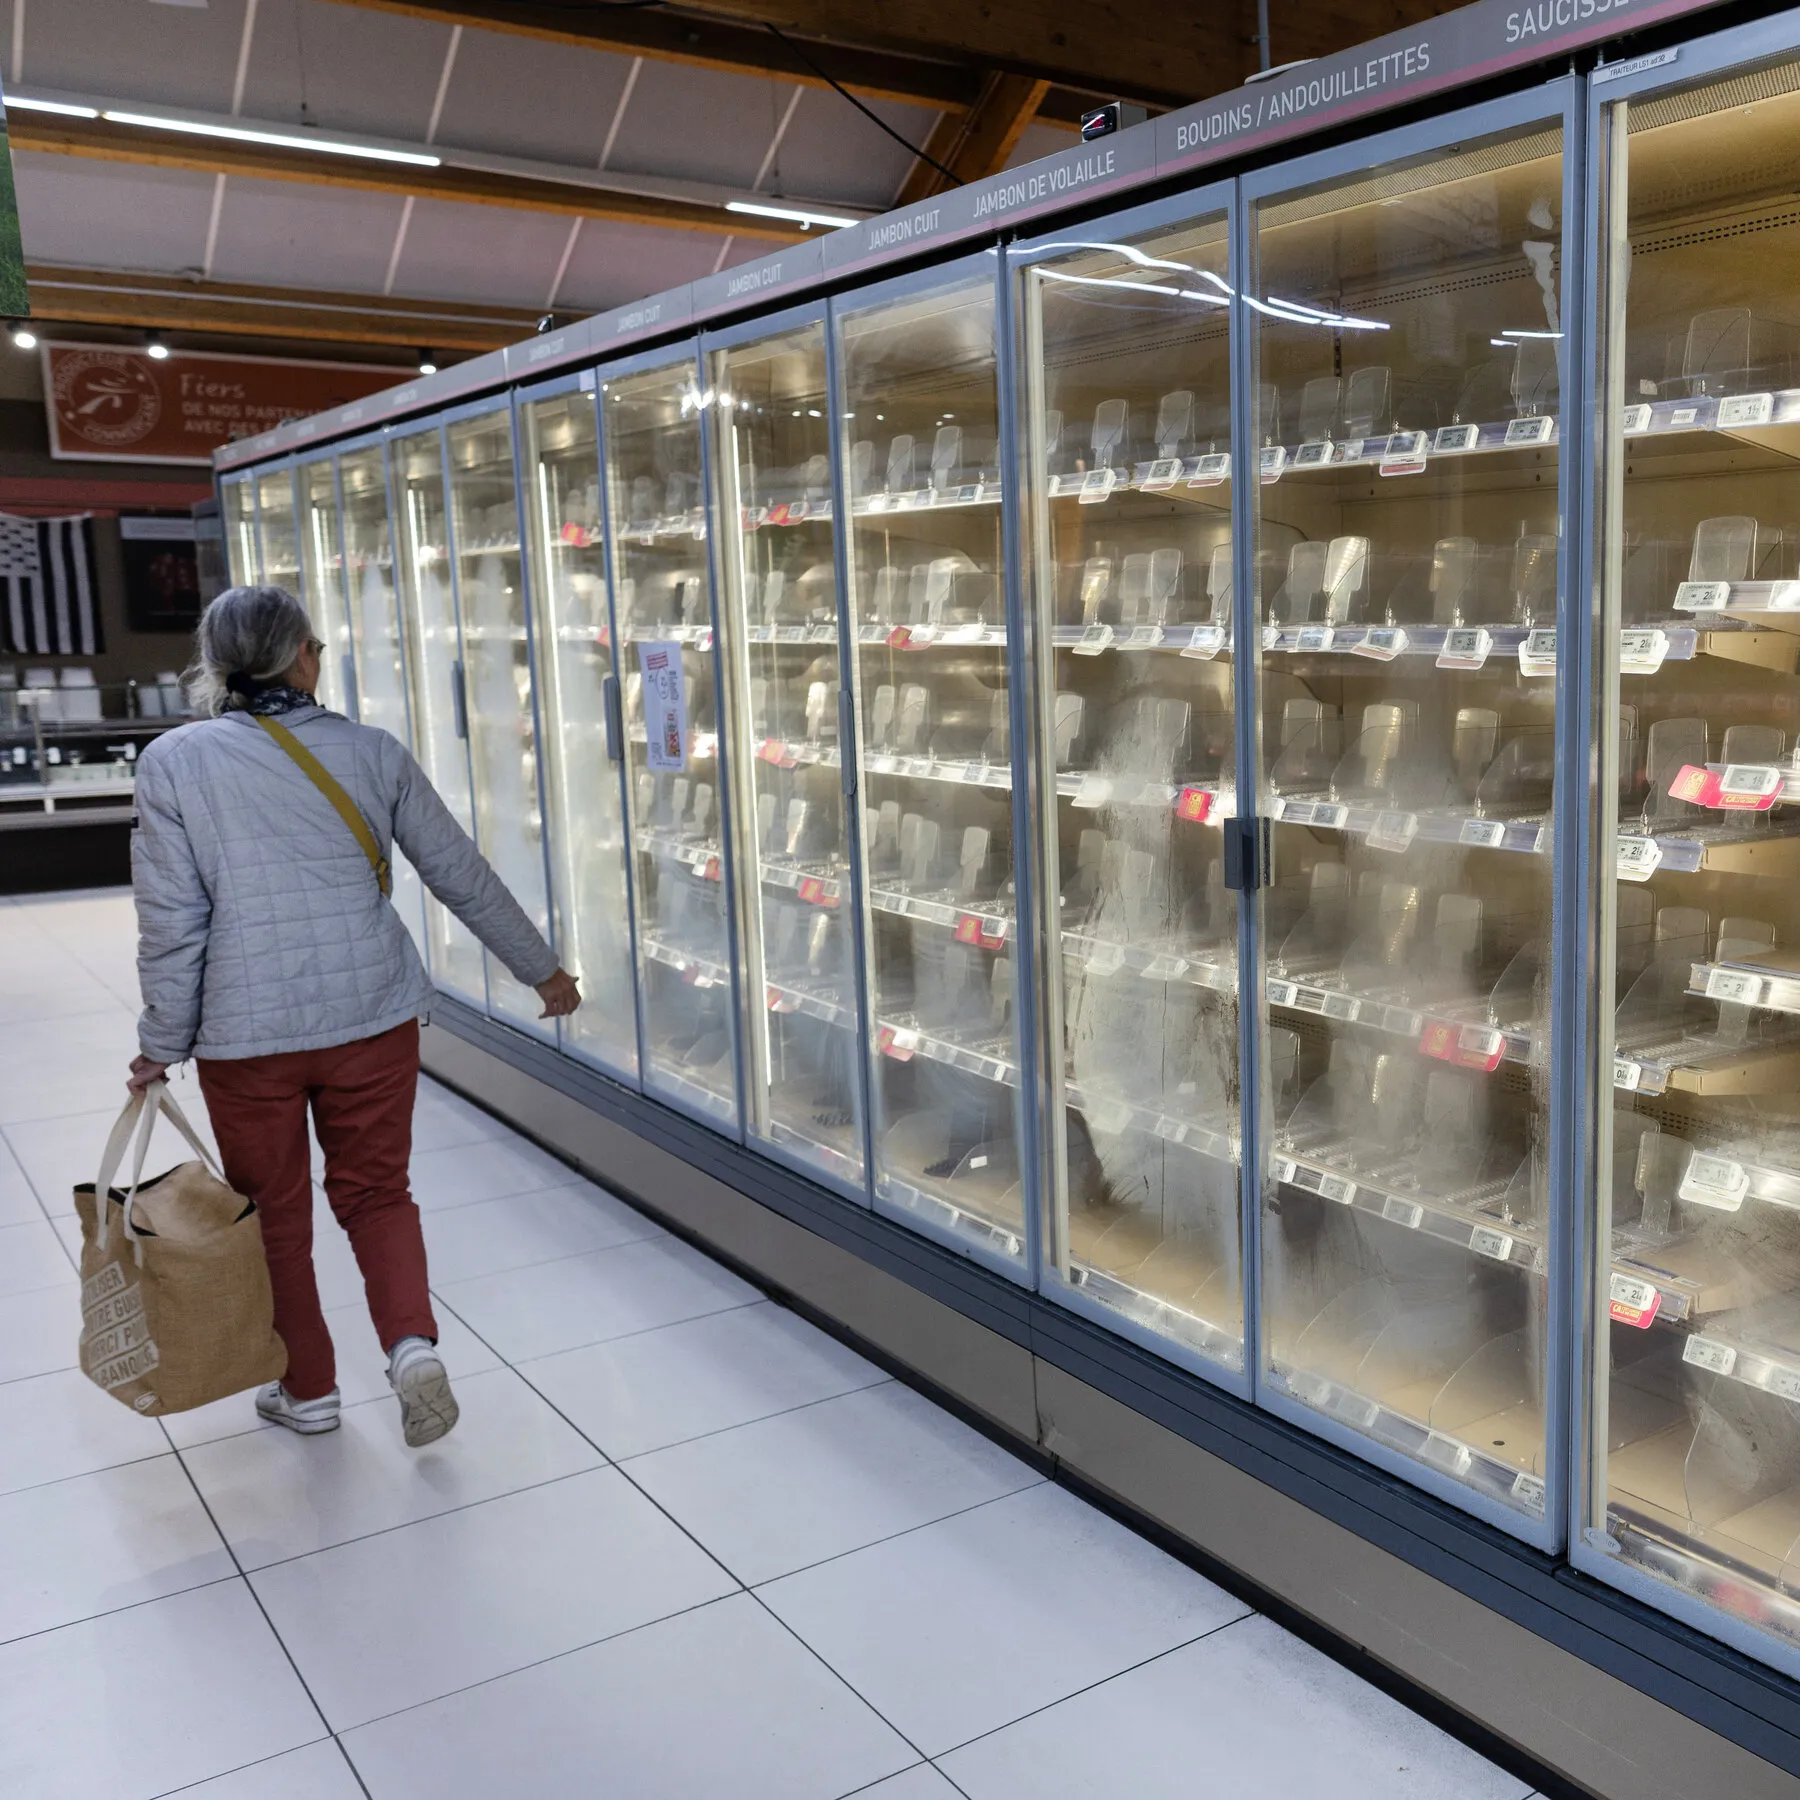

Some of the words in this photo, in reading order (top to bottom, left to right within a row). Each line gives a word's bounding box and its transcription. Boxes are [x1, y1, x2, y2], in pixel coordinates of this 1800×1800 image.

[1505, 0, 1629, 43] SAUCIS
[1177, 104, 1252, 150] BOUDINS
[1256, 96, 1265, 127] /
[1268, 43, 1430, 121] ANDOUILLETTES
[973, 182, 1026, 218] JAMBON
[1029, 174, 1047, 199] DE
[1049, 150, 1115, 192] VOLAILLE
[868, 217, 912, 250] JAMBON
[914, 209, 941, 235] CUIT
[727, 272, 761, 298] JAMBON
[762, 263, 782, 286] CUIT
[180, 373, 246, 399] Fiers
[182, 401, 204, 416] DE
[207, 403, 242, 418] NOS
[184, 420, 224, 434] AVEC
